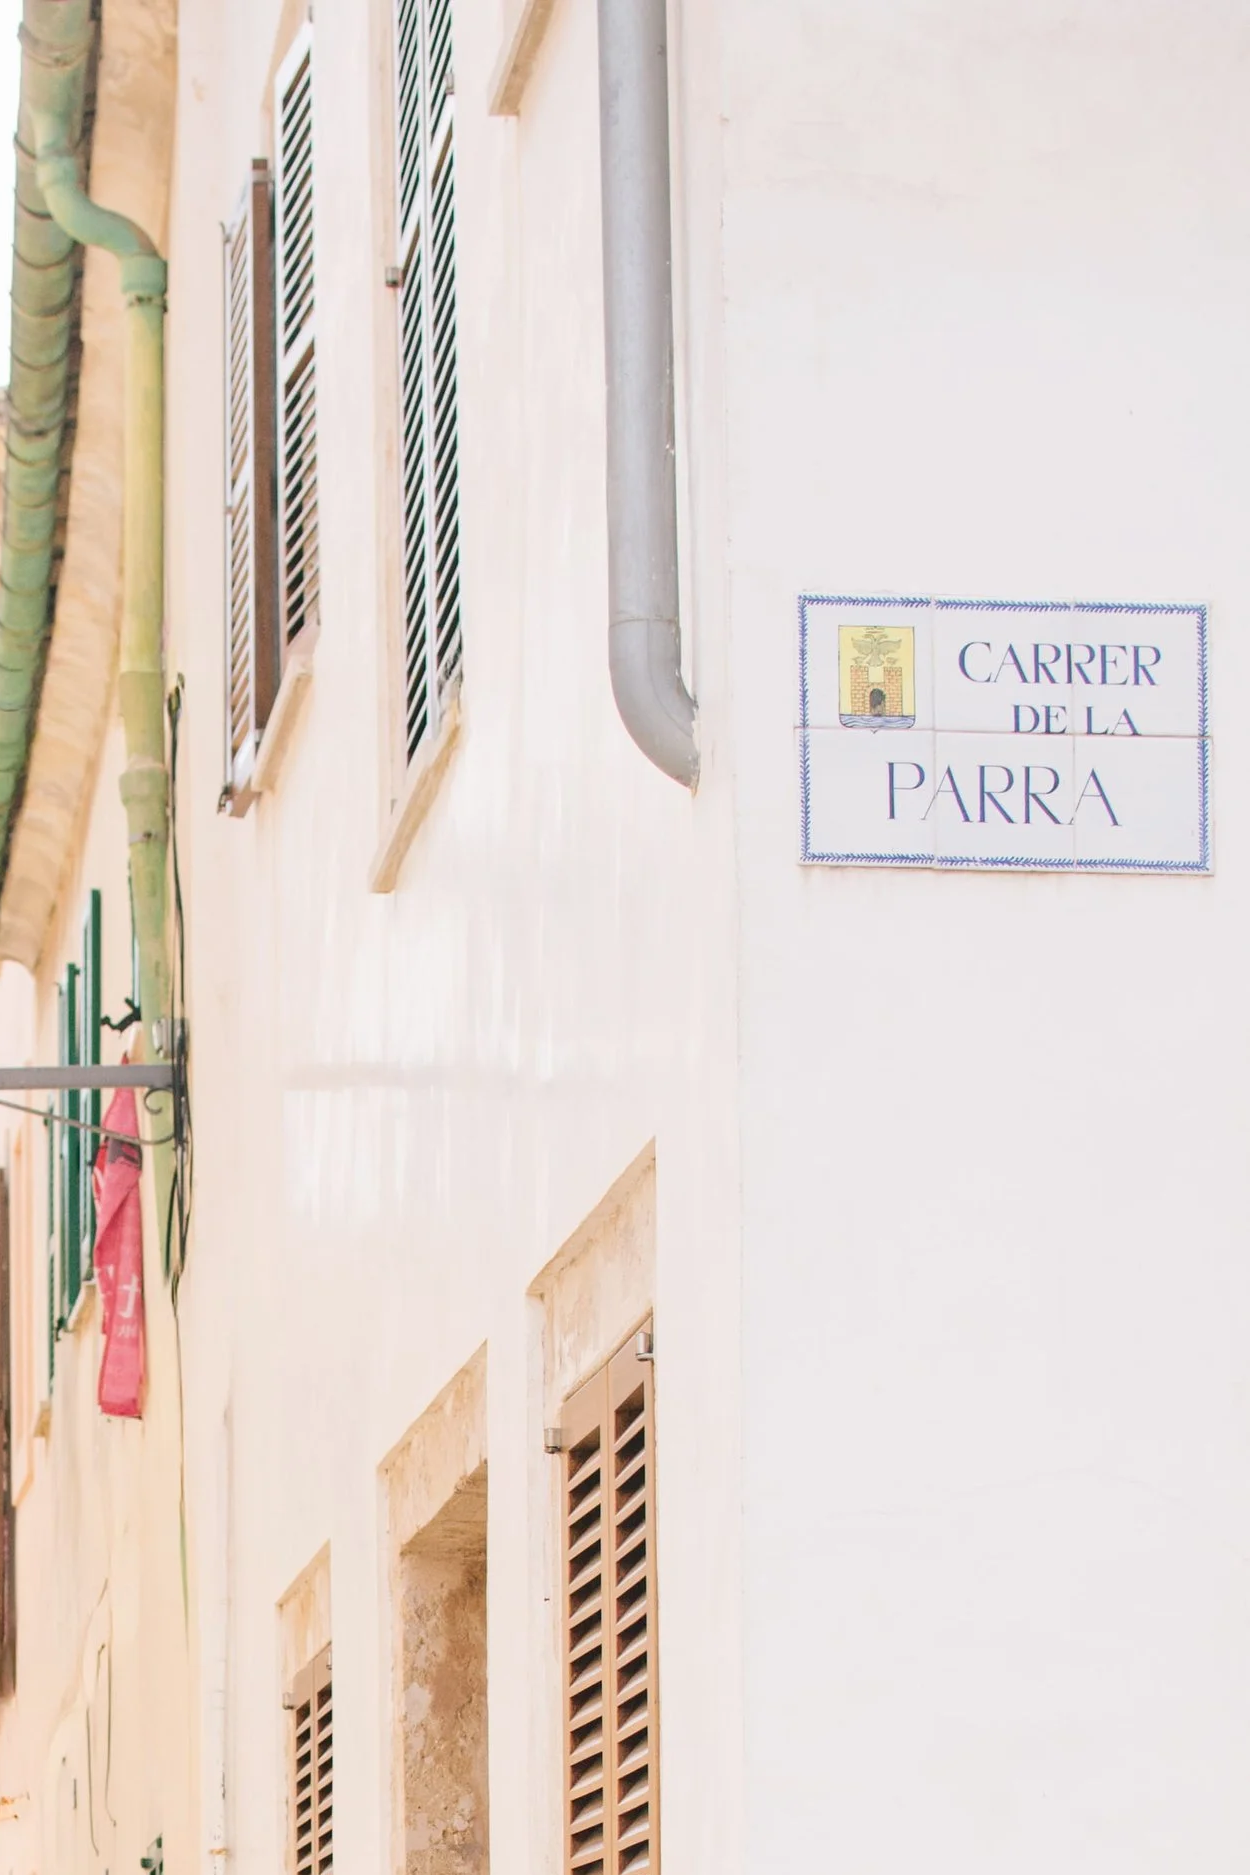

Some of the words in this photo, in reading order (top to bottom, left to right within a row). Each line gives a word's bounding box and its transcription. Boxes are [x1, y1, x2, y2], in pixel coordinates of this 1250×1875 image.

[958, 641, 1162, 686] CARRER
[1011, 704, 1068, 735] DE
[1084, 706, 1143, 736] LA
[886, 762, 1123, 827] PARRA
